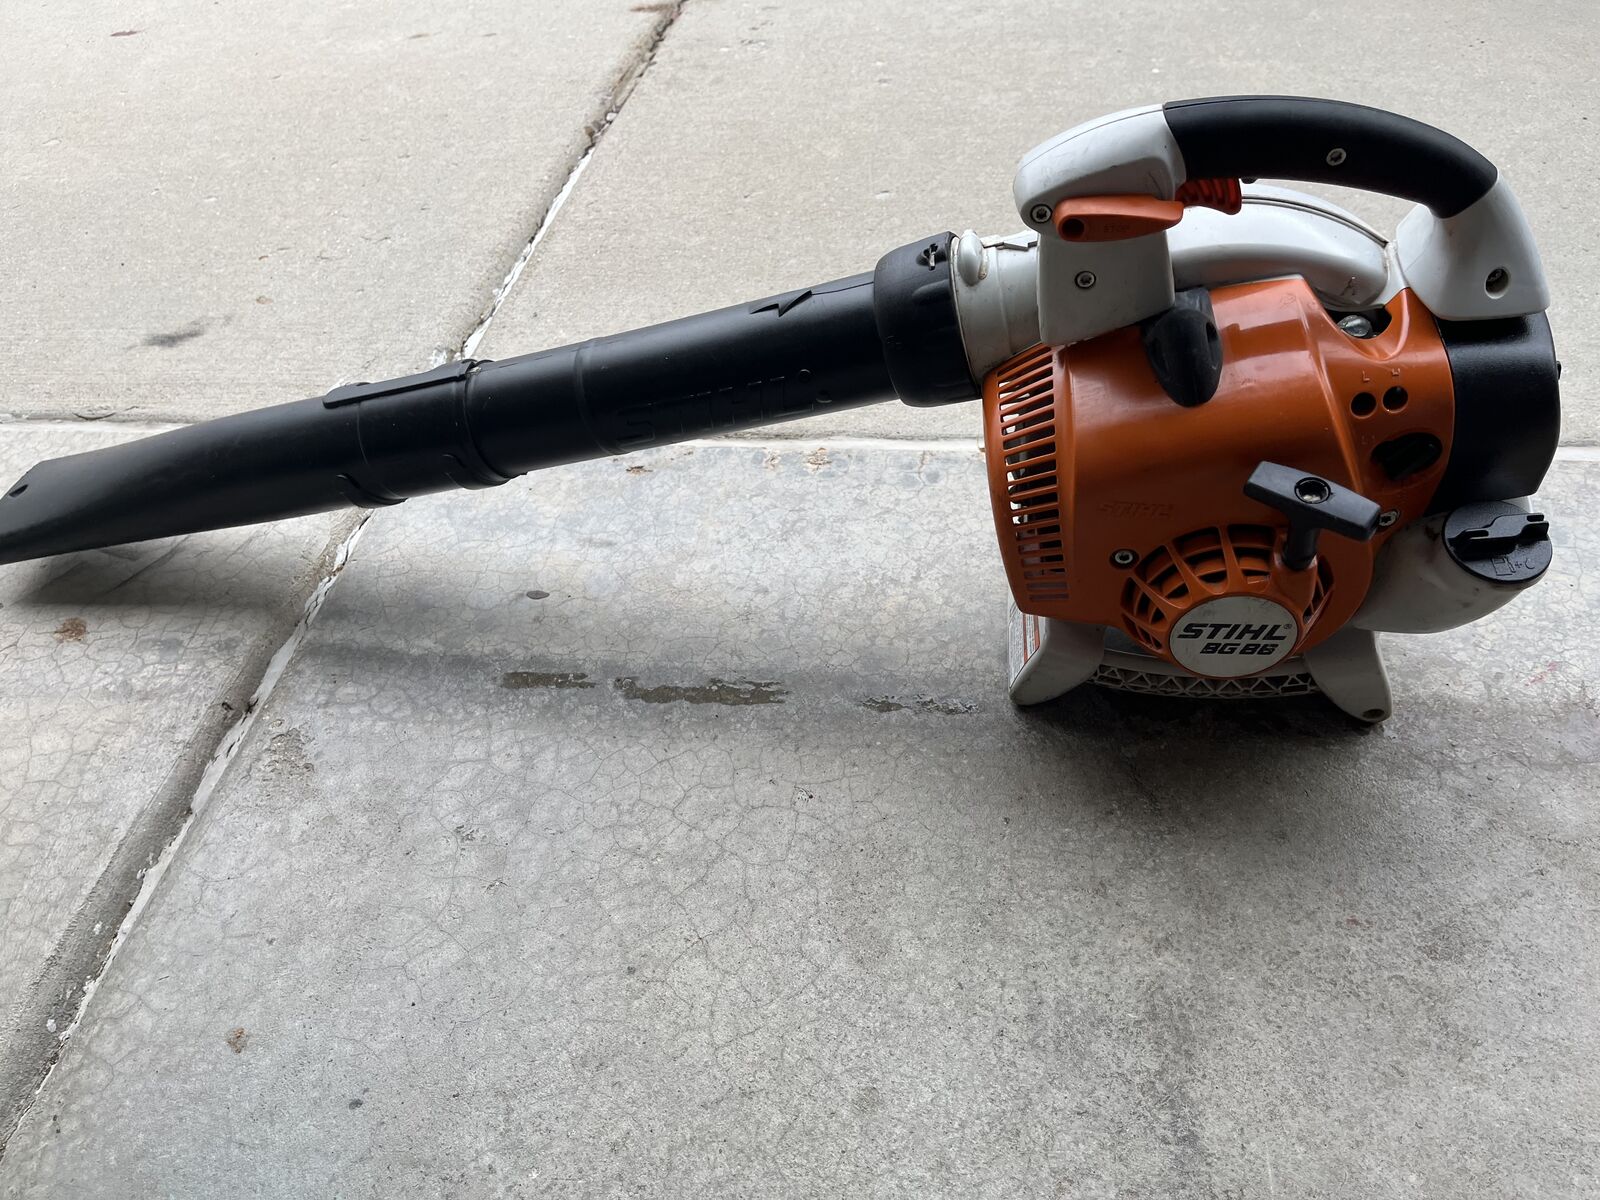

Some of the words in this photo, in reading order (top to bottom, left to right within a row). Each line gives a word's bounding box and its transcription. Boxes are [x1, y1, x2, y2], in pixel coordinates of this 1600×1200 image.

[1097, 501, 1174, 520] STIHL
[1199, 642, 1240, 655] BG
[1238, 643, 1279, 656] 86
